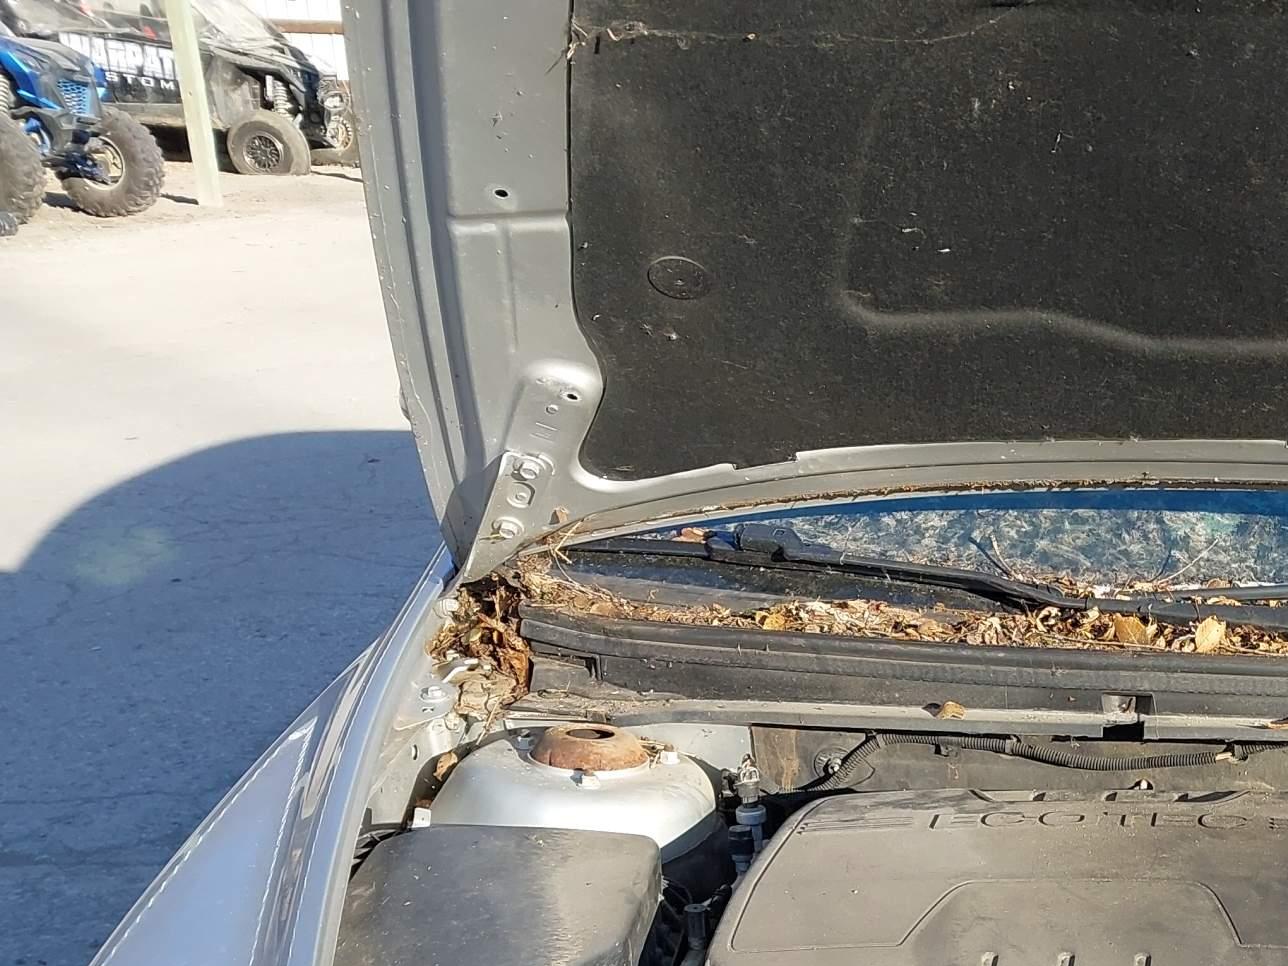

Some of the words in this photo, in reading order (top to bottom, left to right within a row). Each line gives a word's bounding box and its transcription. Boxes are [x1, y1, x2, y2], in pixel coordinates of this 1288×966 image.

[58, 32, 177, 80] WARPAT
[105, 71, 175, 90] STOM
[928, 810, 1248, 830] ECOTEC
